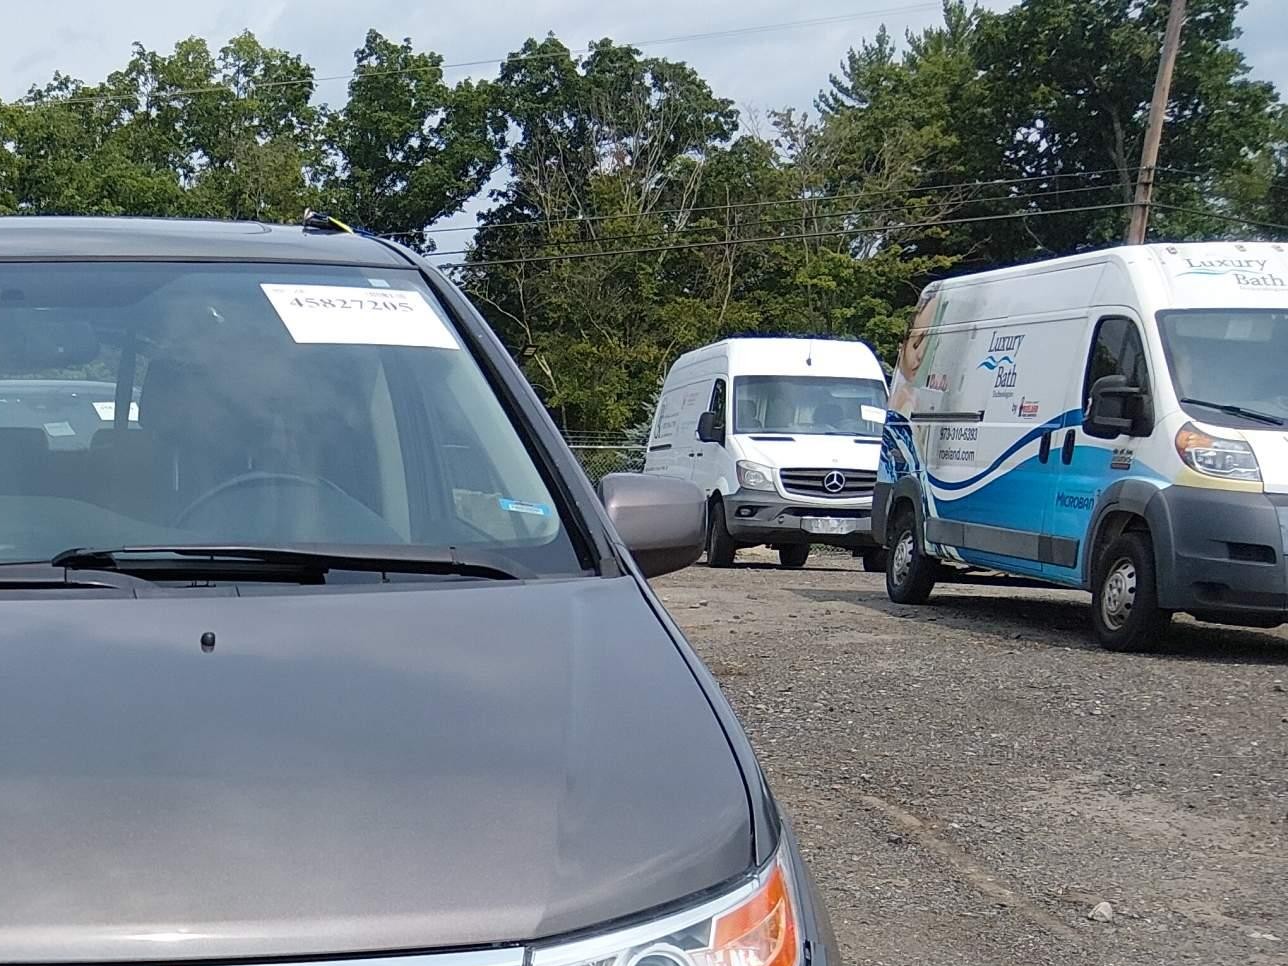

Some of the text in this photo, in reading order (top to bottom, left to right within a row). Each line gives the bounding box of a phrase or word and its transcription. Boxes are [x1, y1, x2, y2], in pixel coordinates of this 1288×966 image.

[1184, 258, 1267, 271] Luxury
[1233, 273, 1287, 287] Bath
[988, 331, 1026, 357] Luxury
[994, 364, 1017, 388] Bath
